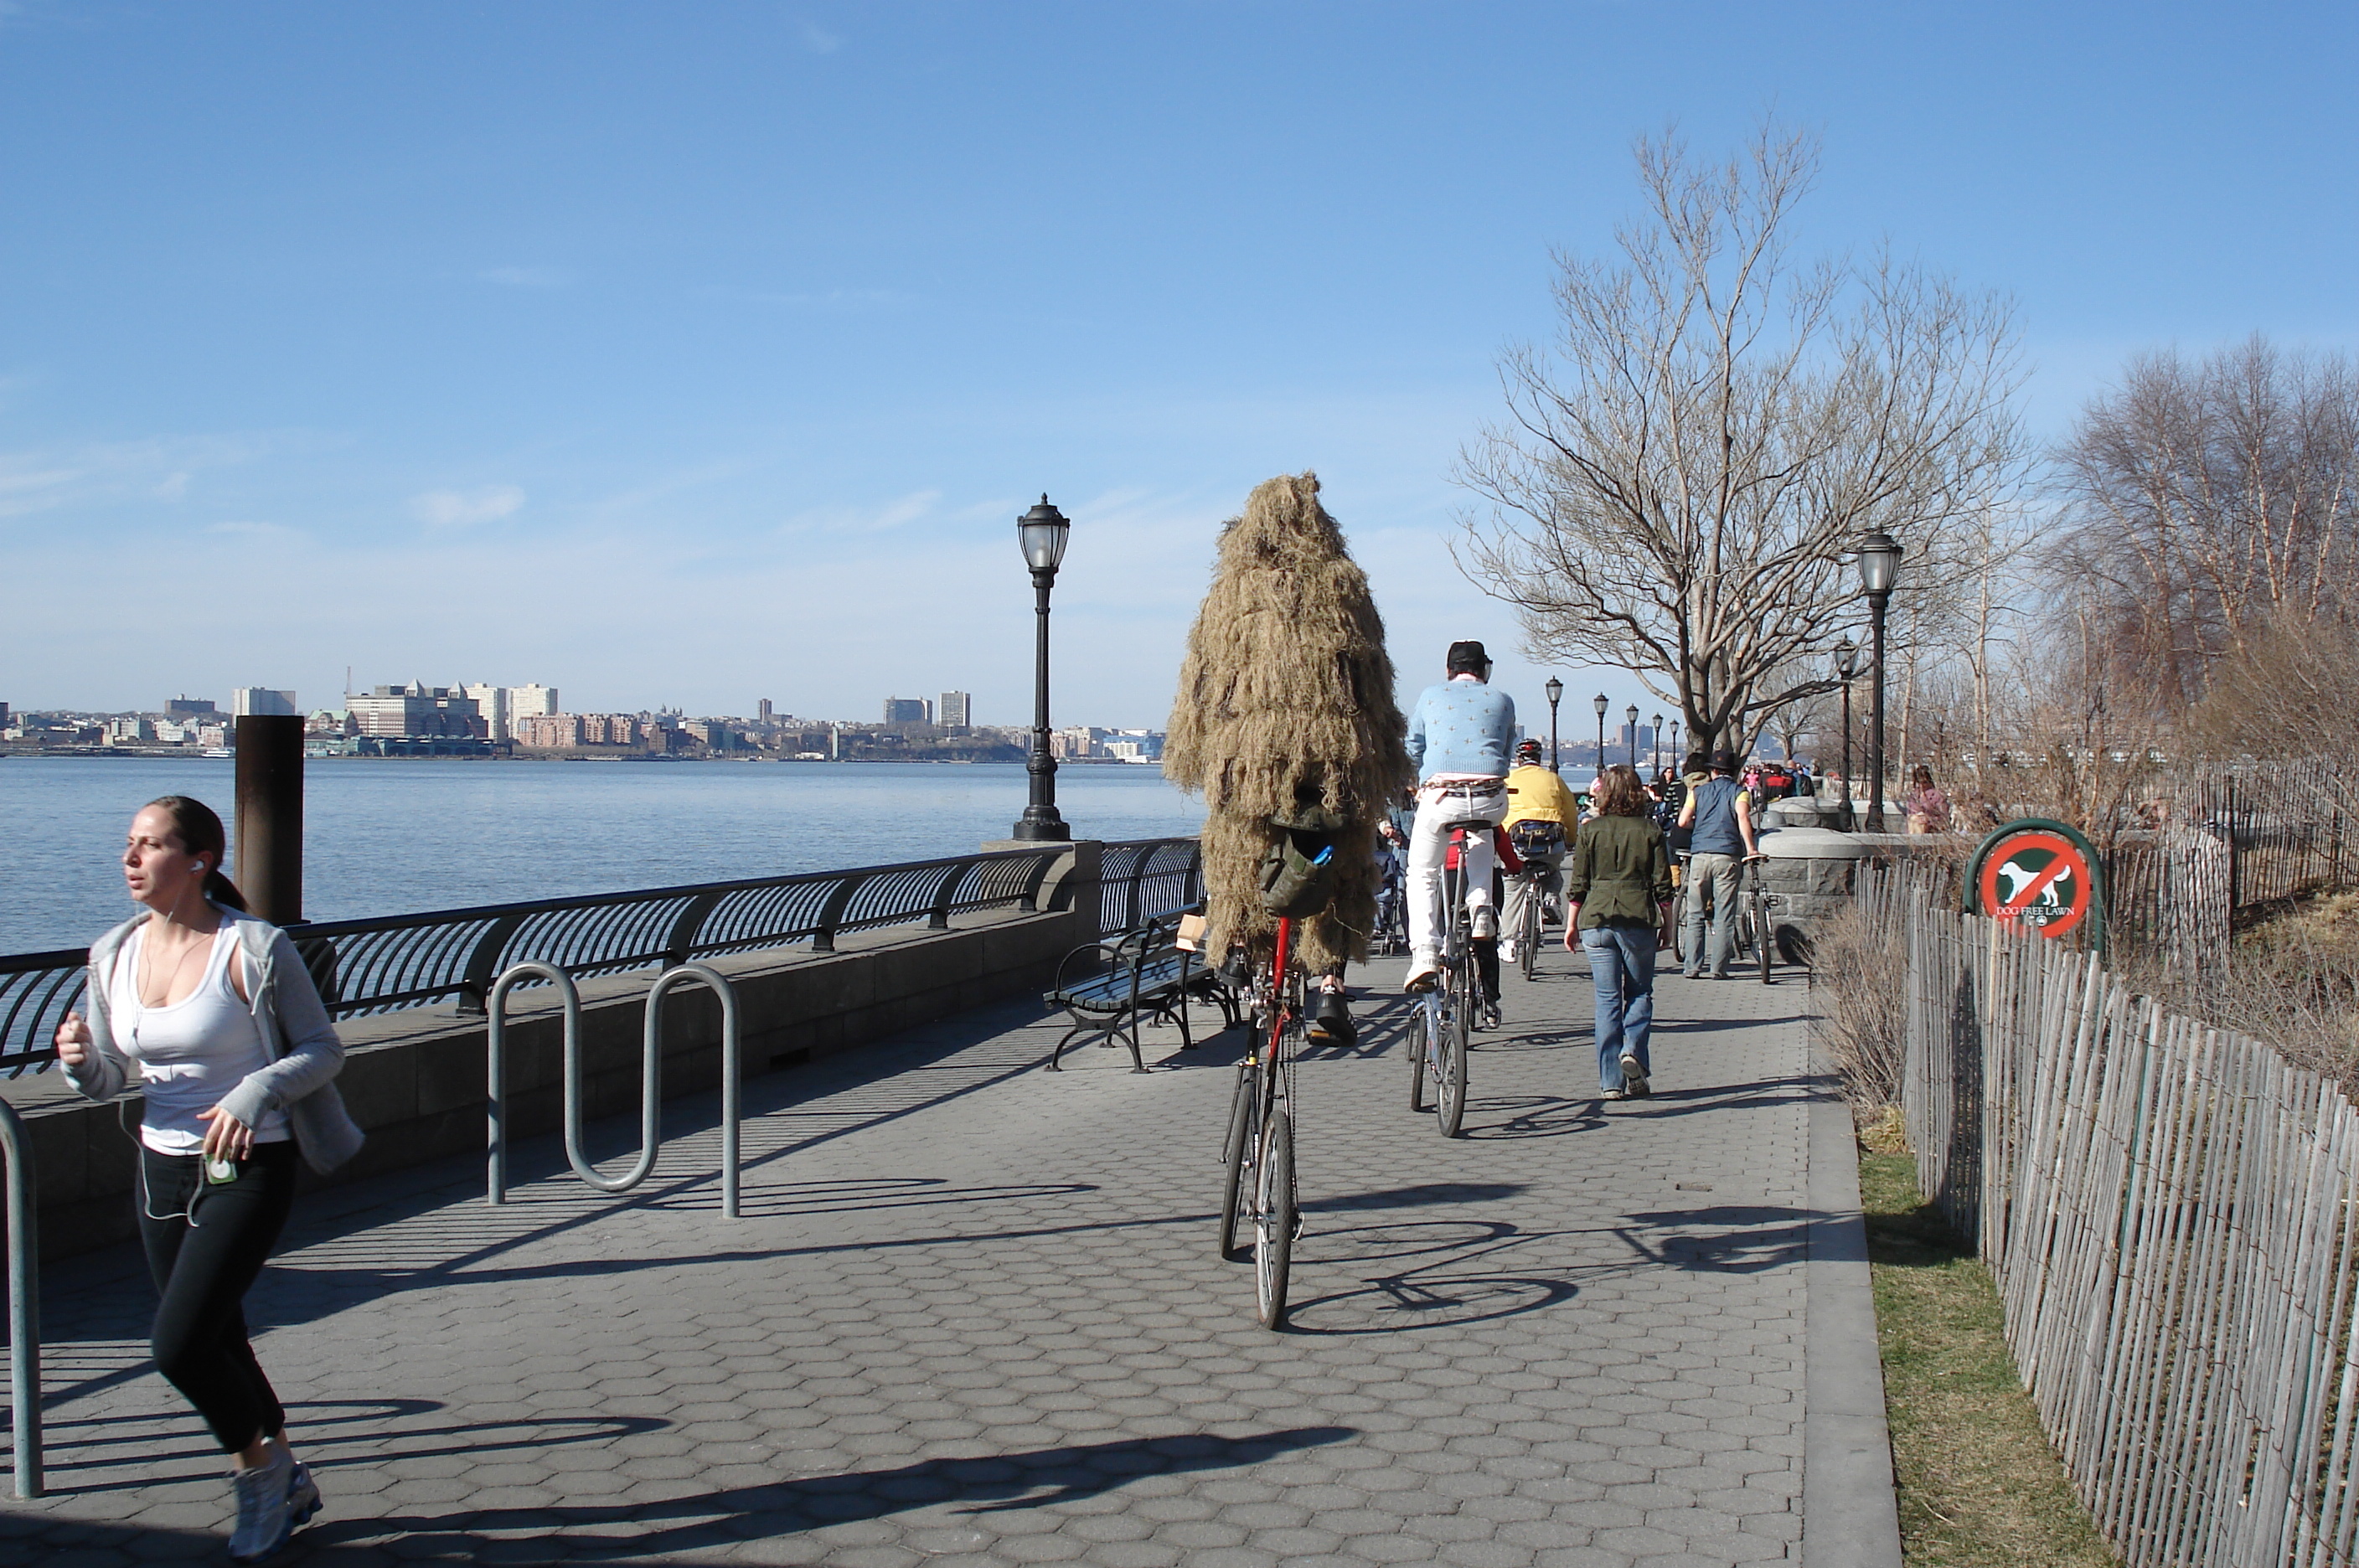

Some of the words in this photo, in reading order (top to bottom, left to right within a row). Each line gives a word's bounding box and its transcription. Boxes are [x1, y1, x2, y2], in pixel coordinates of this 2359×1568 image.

[1996, 906, 2019, 916] DOG
[2021, 906, 2044, 916] FREE
[2045, 906, 2075, 916] LAWN
